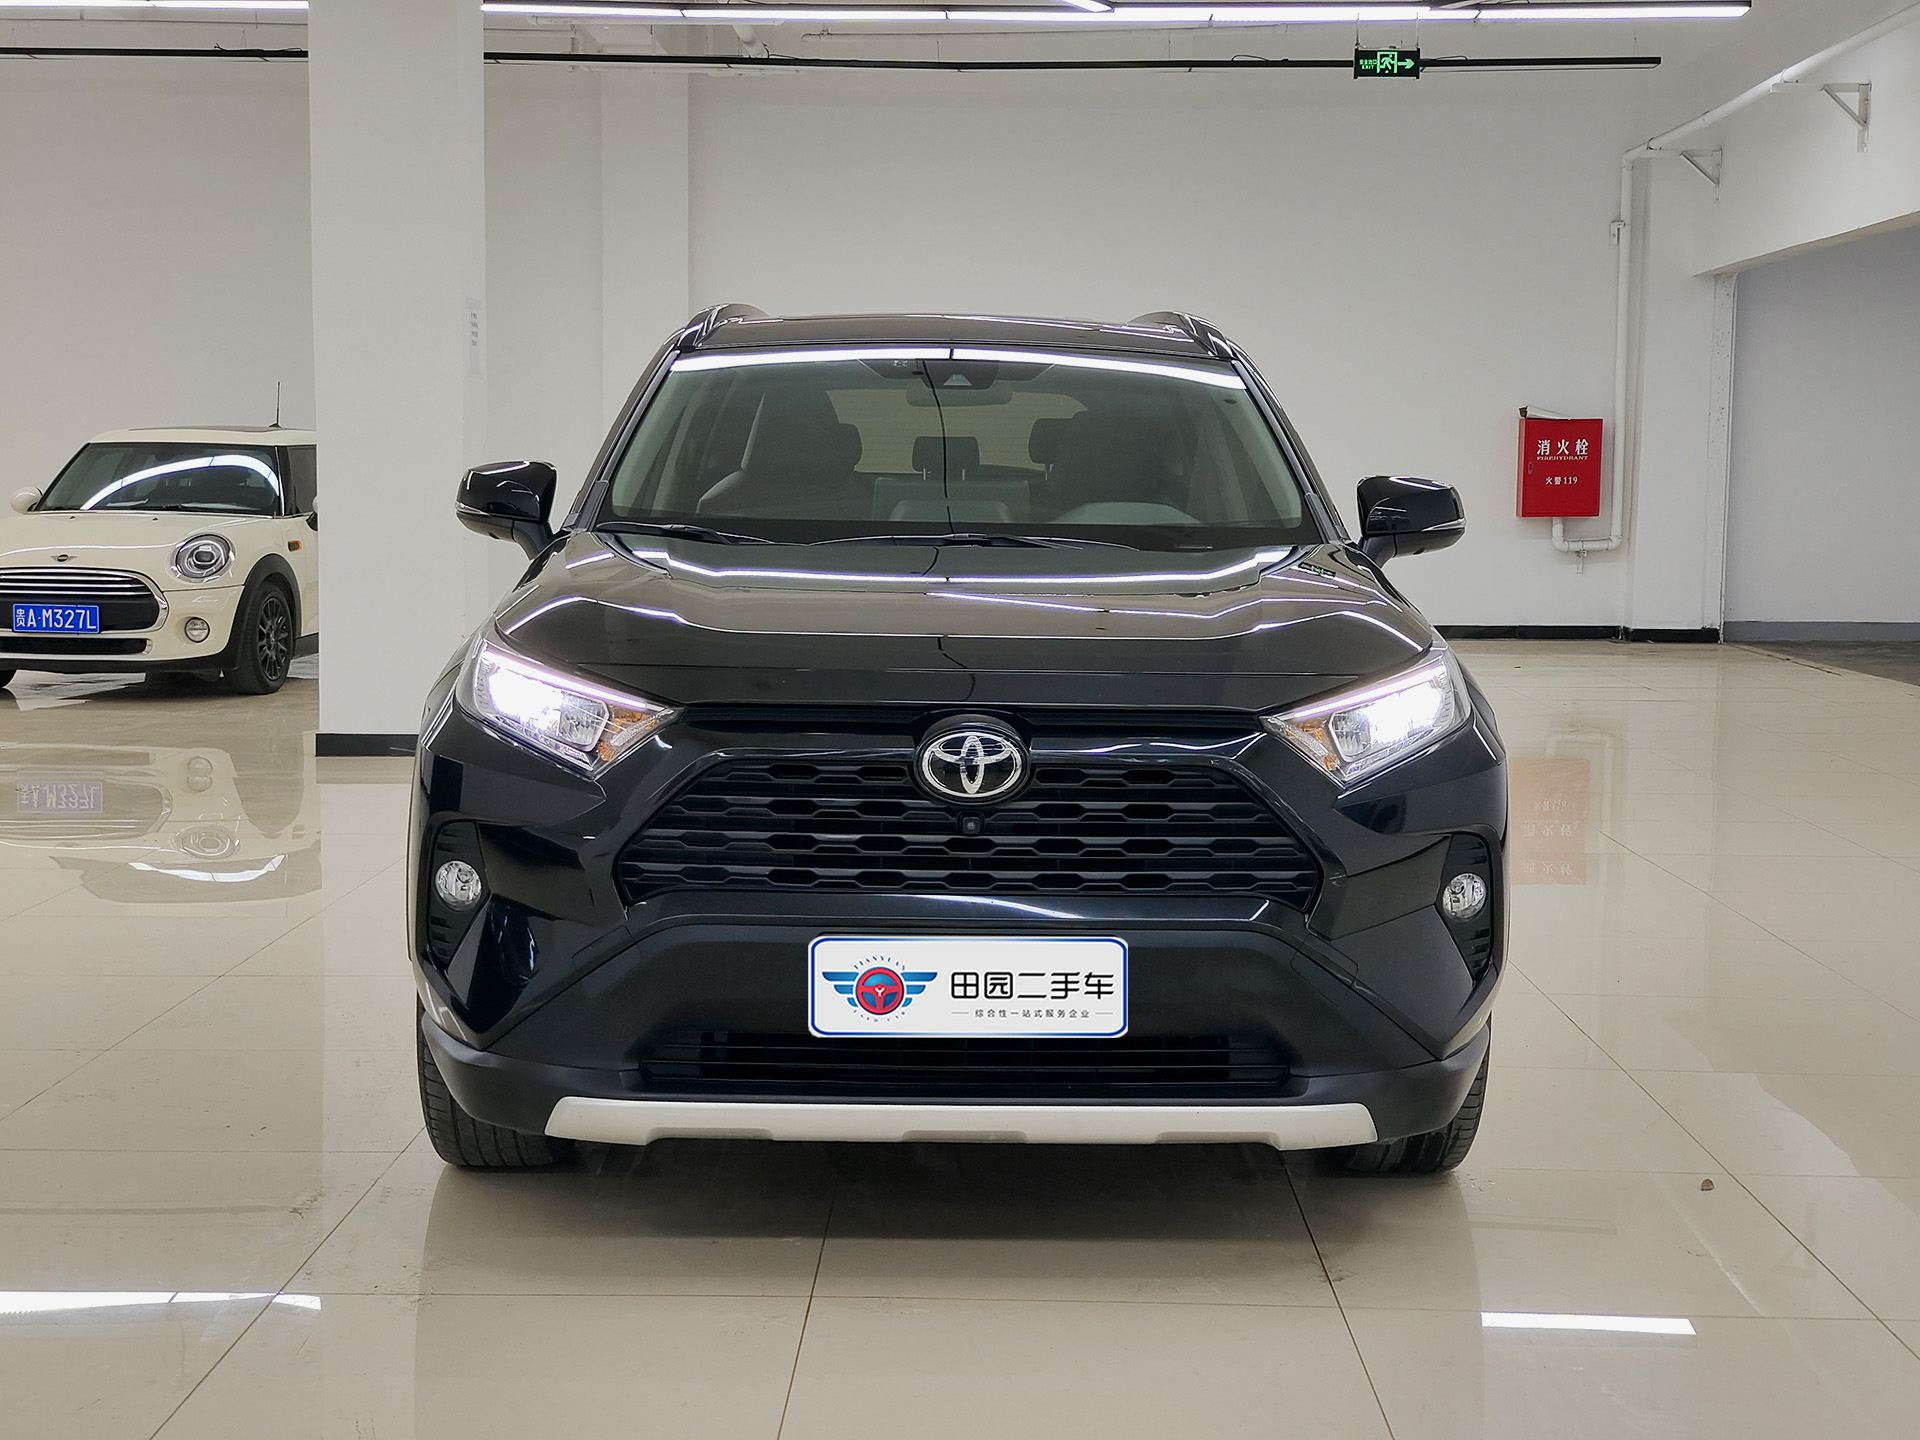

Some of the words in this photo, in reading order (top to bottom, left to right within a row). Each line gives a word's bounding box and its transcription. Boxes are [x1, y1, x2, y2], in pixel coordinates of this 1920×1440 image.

[1536, 438, 1589, 456] 消火栓
[951, 971, 1115, 1000] 田园二手车
[974, 1008, 1090, 1019] 综合性一站式服务企业
